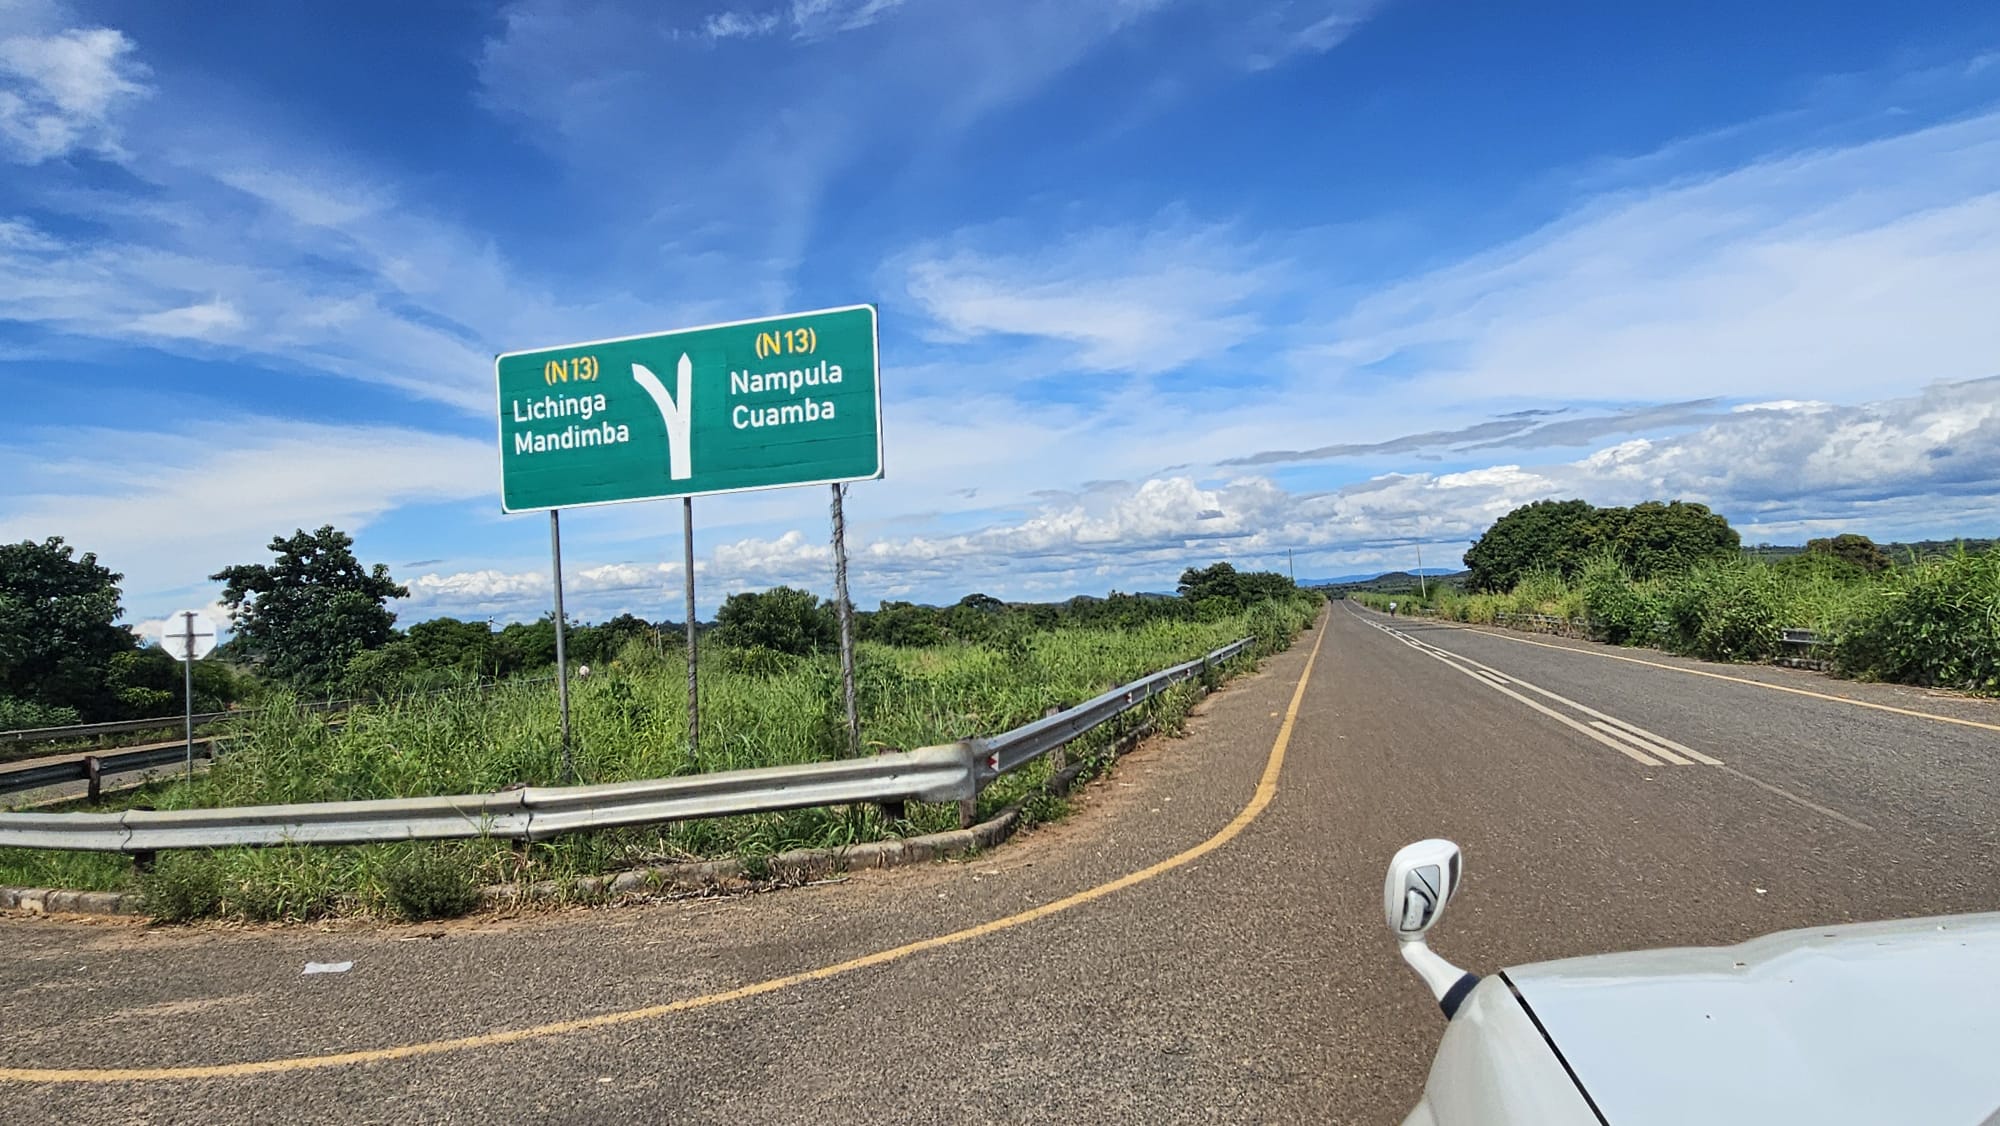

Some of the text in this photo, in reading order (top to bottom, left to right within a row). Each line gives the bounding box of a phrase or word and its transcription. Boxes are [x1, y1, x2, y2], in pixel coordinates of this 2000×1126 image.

[730, 360, 843, 395] Nampula
[513, 393, 606, 423] Lichinga
[732, 397, 835, 430] Cuamba
[514, 421, 629, 455] Mandimba
